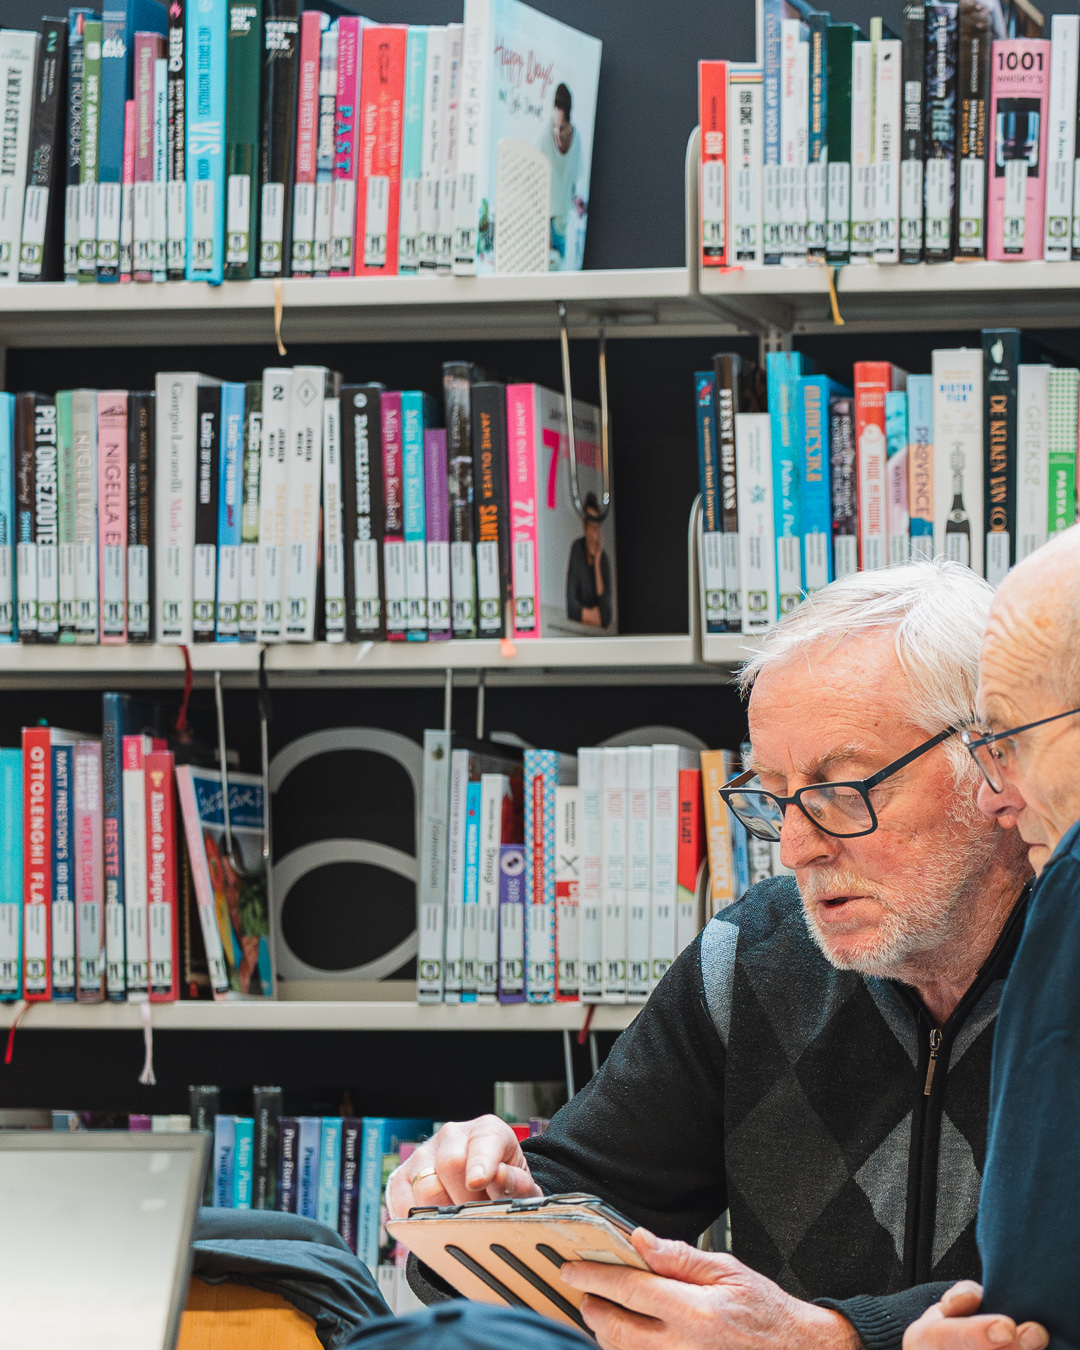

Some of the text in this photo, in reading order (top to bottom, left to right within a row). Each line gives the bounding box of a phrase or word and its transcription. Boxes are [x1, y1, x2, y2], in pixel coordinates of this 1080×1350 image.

[765, 13, 780, 75] cocktails
[997, 51, 1044, 72] 1001
[188, 120, 221, 155] VIS
[704, 131, 724, 155] GIN
[931, 98, 951, 142] THEE
[34, 405, 57, 445] PIET
[515, 401, 528, 438] JAMIE
[719, 388, 737, 510] FEEST BIJ ONS
[988, 395, 1008, 503] DE KEUKEN VAN
[1023, 405, 1042, 487] GRIEKSE
[104, 443, 121, 525] NIGELLA
[480, 412, 494, 499] JAMIE OLIVER
[542, 427, 561, 510] 7
[913, 426, 931, 516] PROVENCE
[1055, 470, 1068, 516] PASTA
[30, 746, 46, 865] OTTOLENGHI
[104, 817, 119, 877] BESTE
